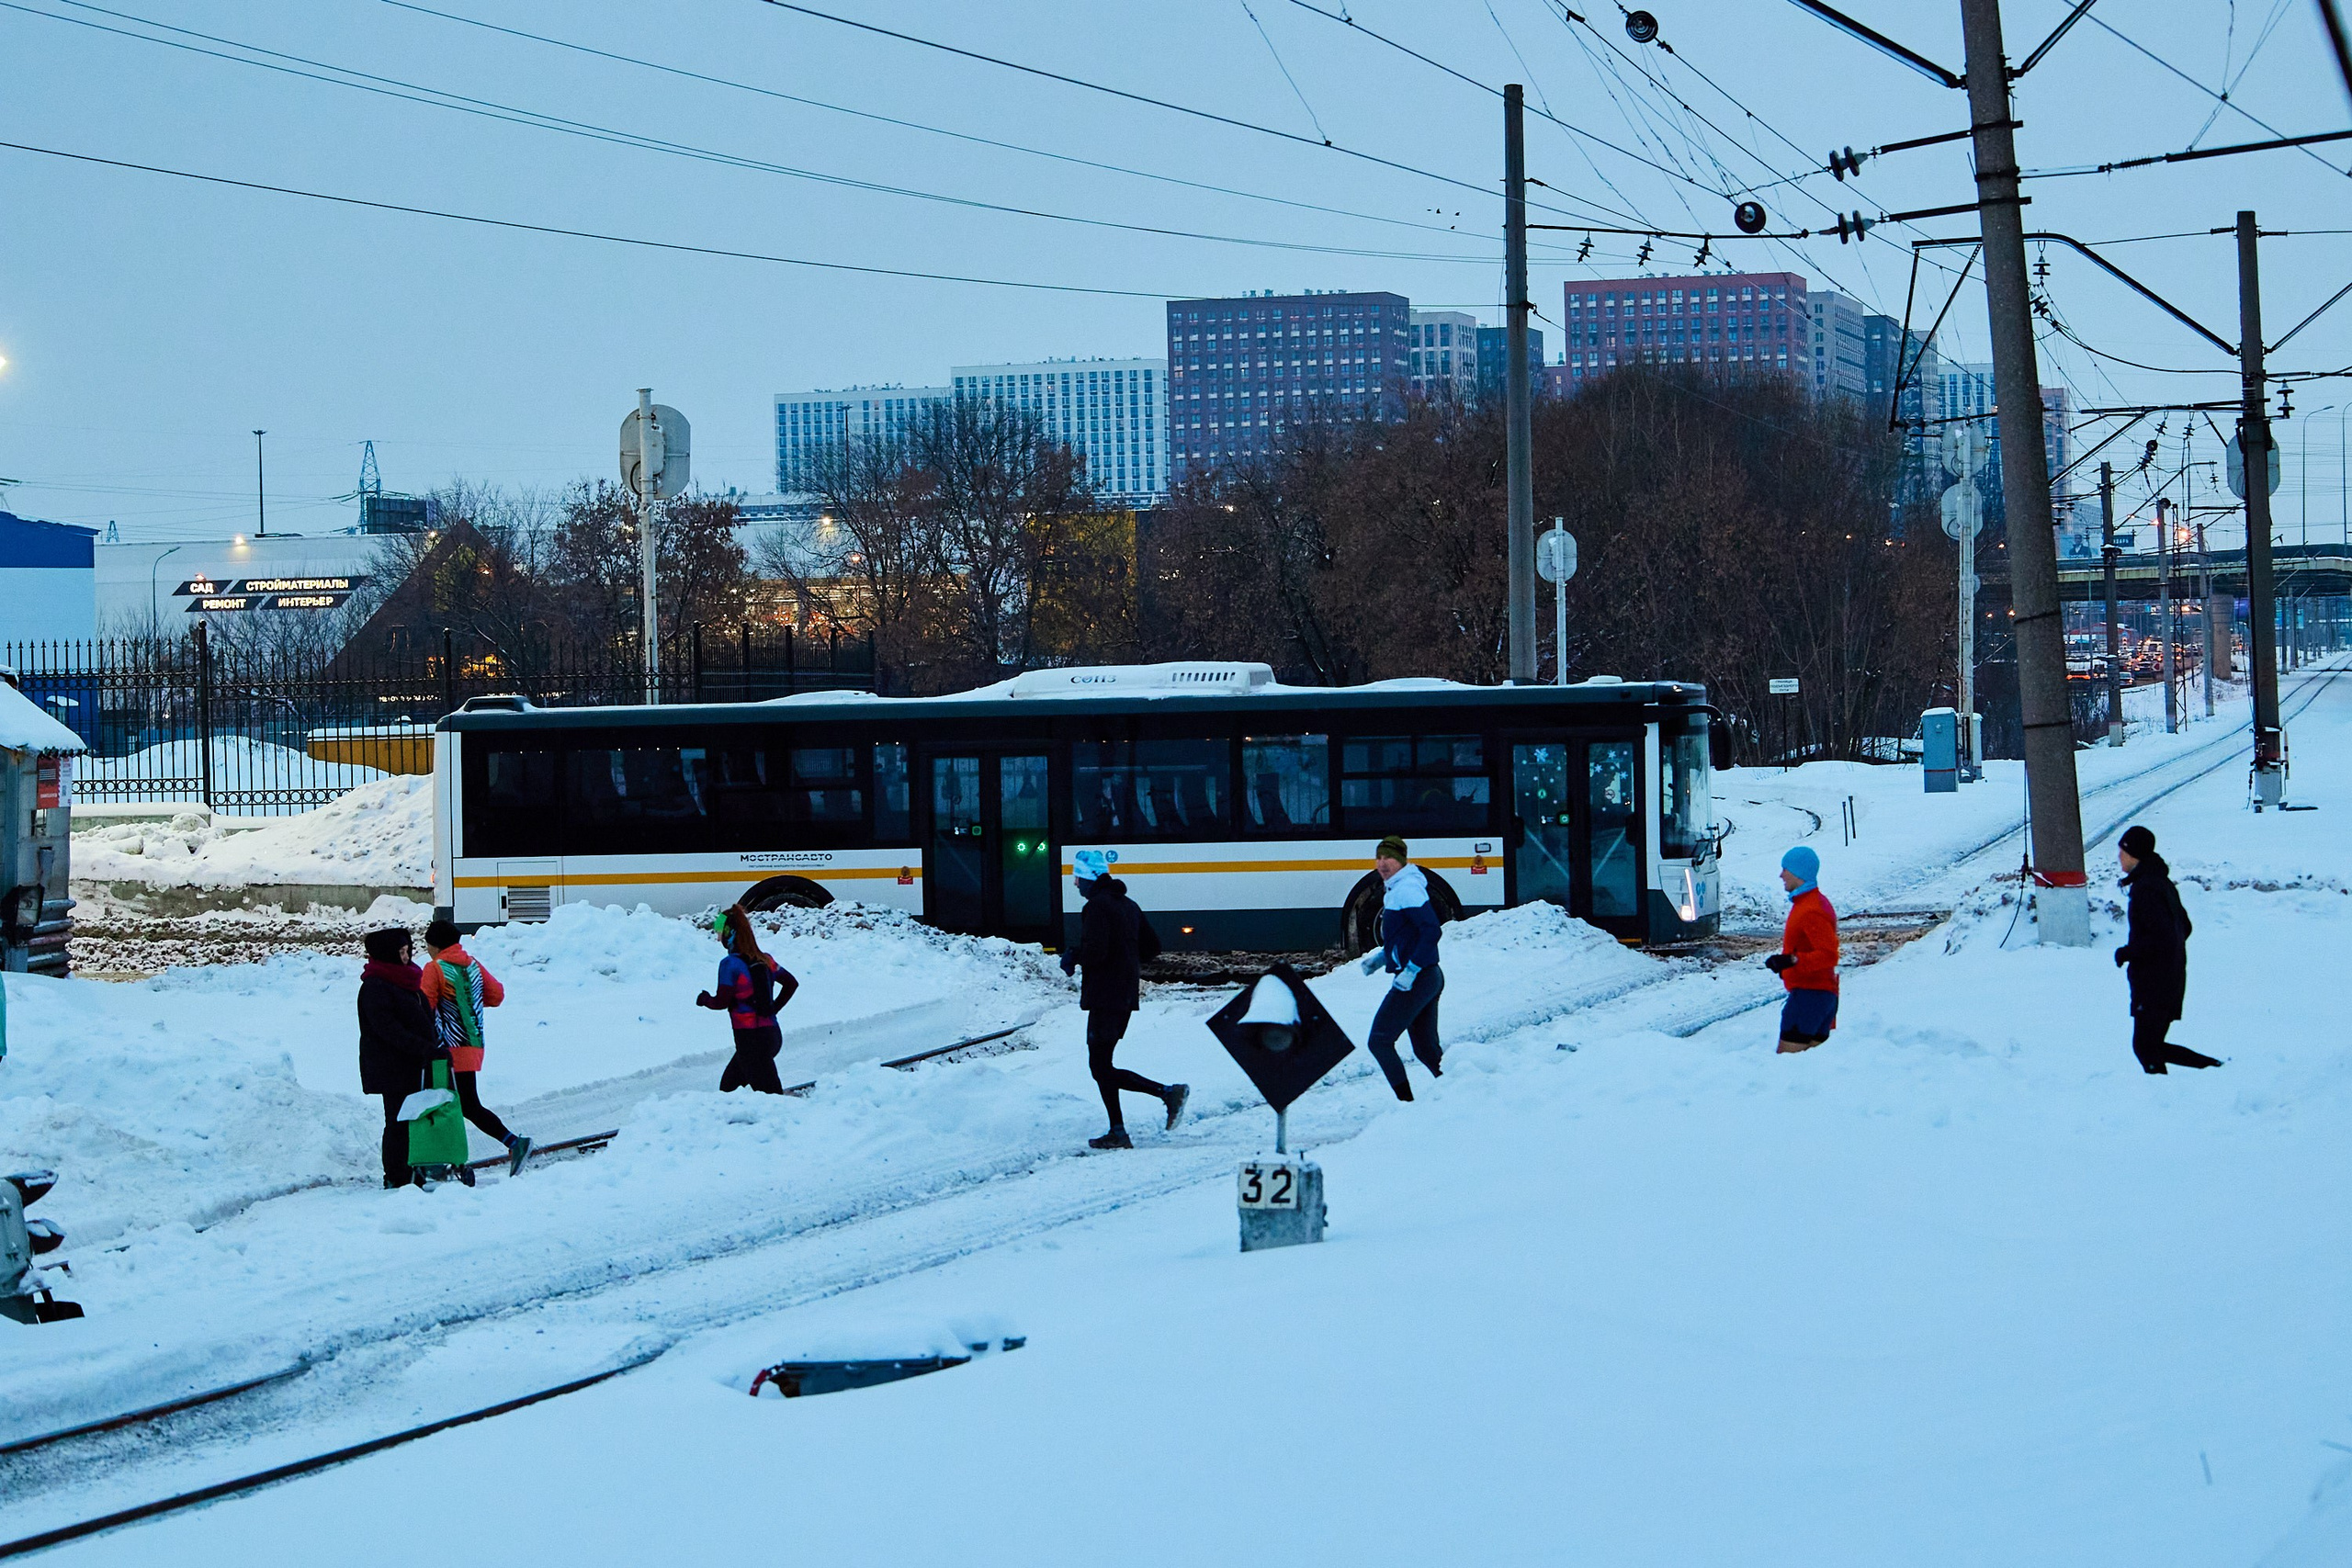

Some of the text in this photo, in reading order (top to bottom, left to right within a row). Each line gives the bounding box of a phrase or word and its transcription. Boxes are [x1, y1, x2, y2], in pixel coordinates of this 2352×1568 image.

[189, 582, 214, 593] САД
[246, 579, 349, 592] СТРОЙМАТЕРИАЛЫ
[202, 598, 246, 609] РЕМОНТ
[277, 596, 334, 607] ИНТЕРЬЕР
[741, 853, 832, 862] МОСТРАНСАВТО
[1242, 1168, 1292, 1203] 32
